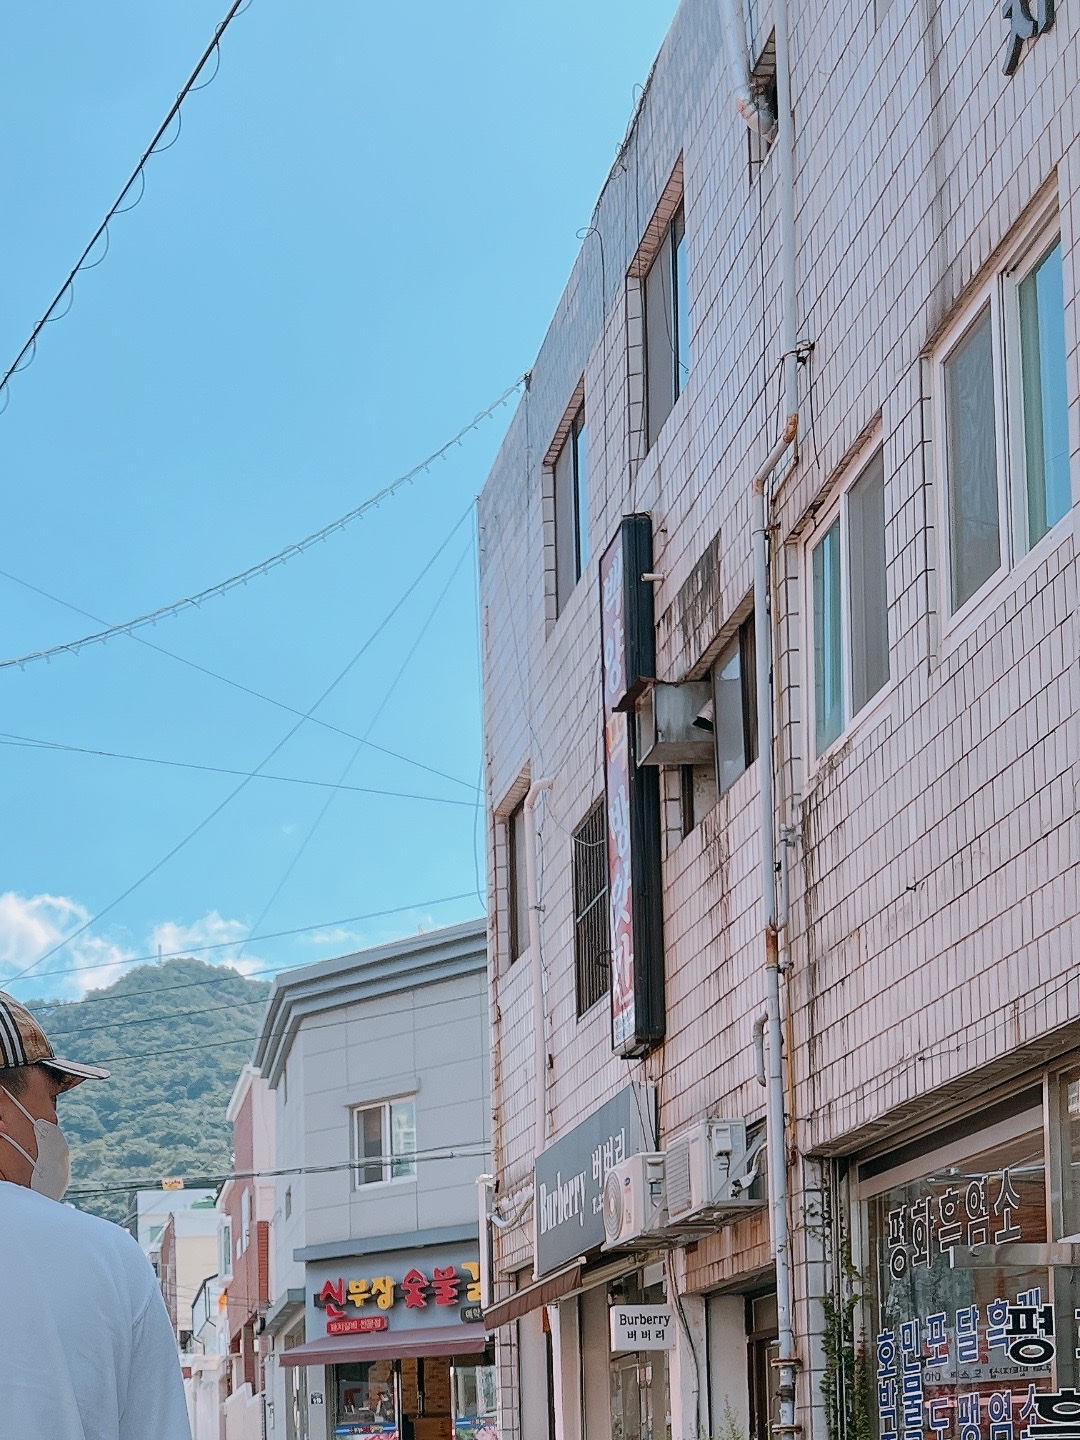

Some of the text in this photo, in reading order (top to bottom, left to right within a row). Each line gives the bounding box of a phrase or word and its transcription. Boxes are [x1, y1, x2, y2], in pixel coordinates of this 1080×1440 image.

[591, 1128, 626, 1188] 버버리
[539, 1171, 587, 1235] Burberry
[619, 1314, 671, 1327] Burberry
